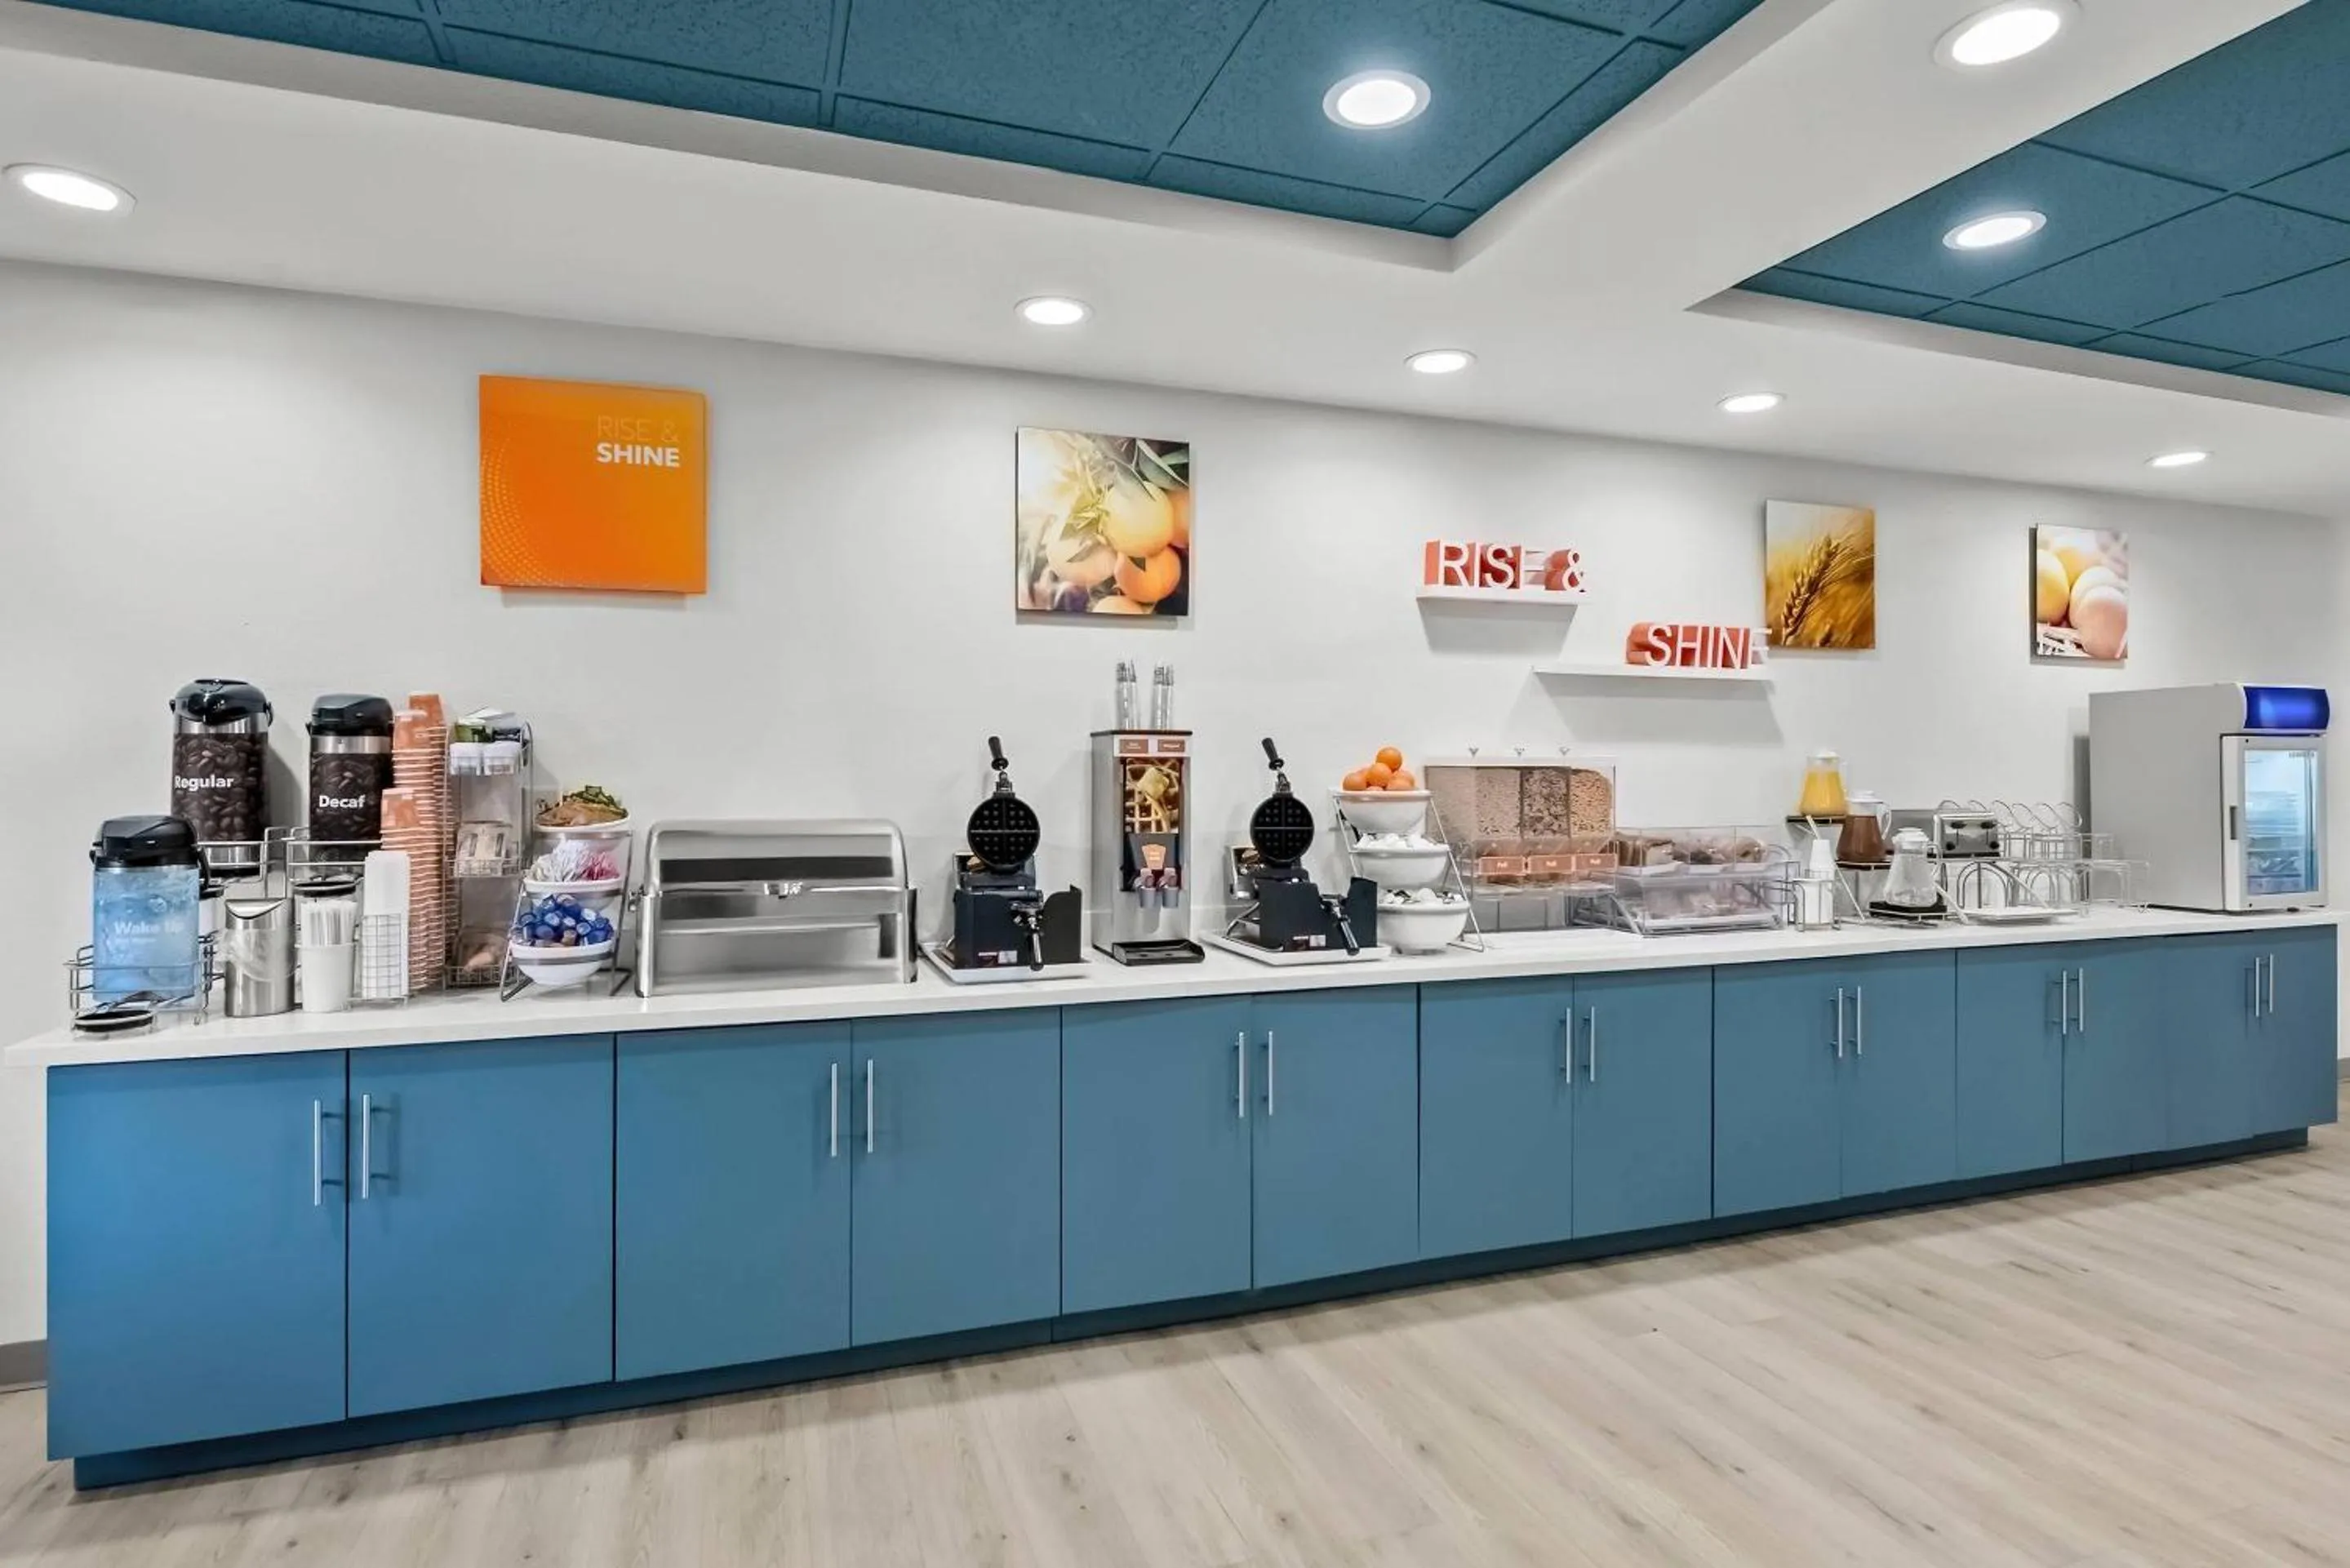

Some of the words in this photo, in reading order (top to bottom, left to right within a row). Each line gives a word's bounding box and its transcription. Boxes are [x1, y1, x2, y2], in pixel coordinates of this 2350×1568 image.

[597, 415, 652, 442] RISE
[661, 420, 679, 442] &
[596, 442, 681, 468] SHINE
[1426, 541, 1546, 589] RISE
[1554, 547, 1587, 593] &
[1628, 623, 1773, 670] SHINE
[174, 774, 234, 792] Regular
[318, 794, 366, 809] Decaf
[113, 920, 161, 934] Wake
